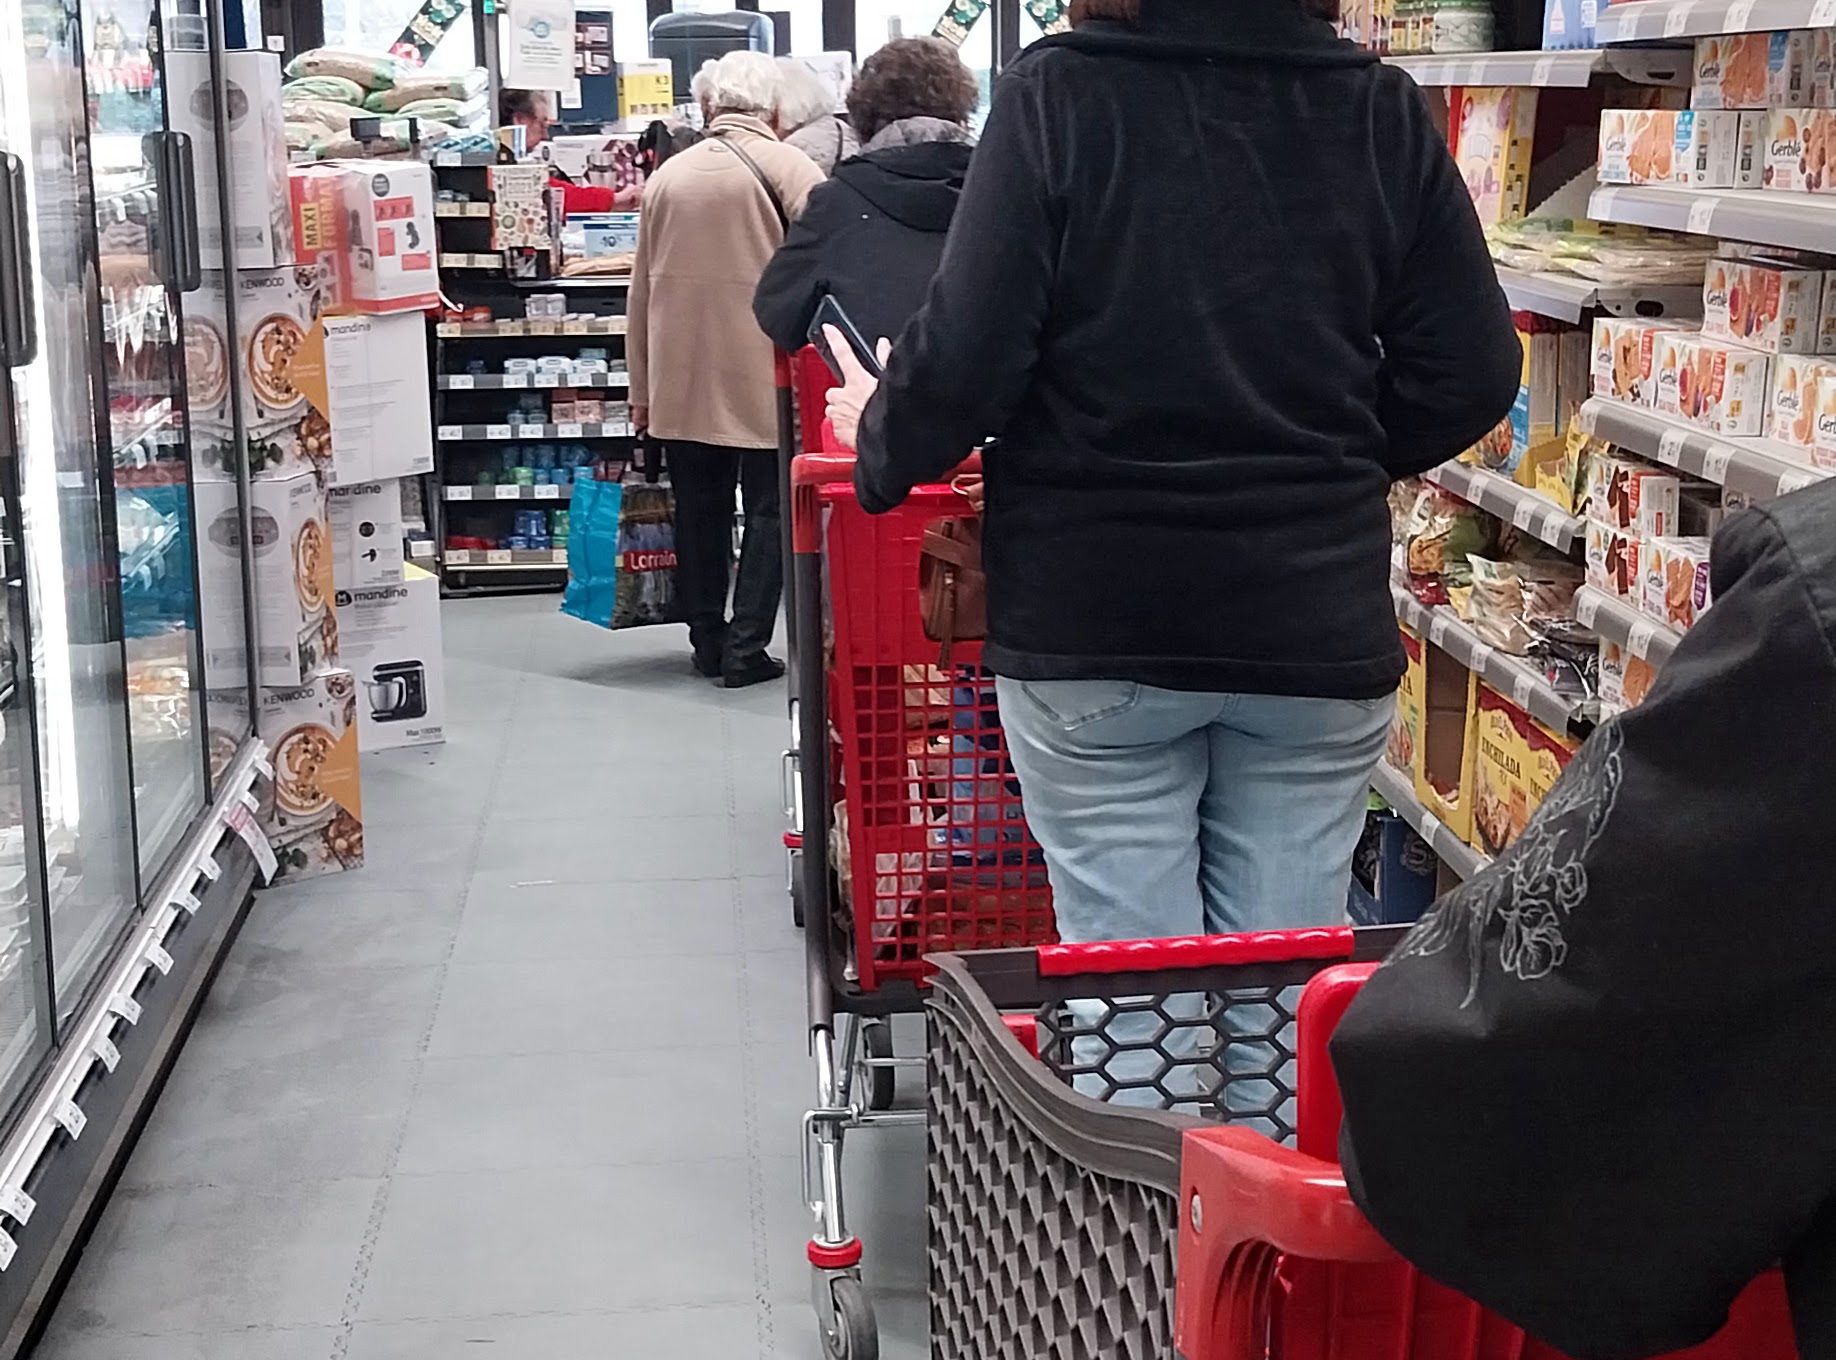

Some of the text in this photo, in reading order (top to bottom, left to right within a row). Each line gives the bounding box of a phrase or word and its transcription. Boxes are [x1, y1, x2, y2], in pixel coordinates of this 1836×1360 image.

[1771, 139, 1801, 157] Gerblé
[303, 207, 318, 247] MAXI
[240, 276, 285, 290] KENWOOD
[330, 322, 371, 335] mandine
[353, 588, 409, 602] mandine
[263, 688, 315, 706] KENWOOD
[1481, 736, 1521, 780] ENCHILADA
